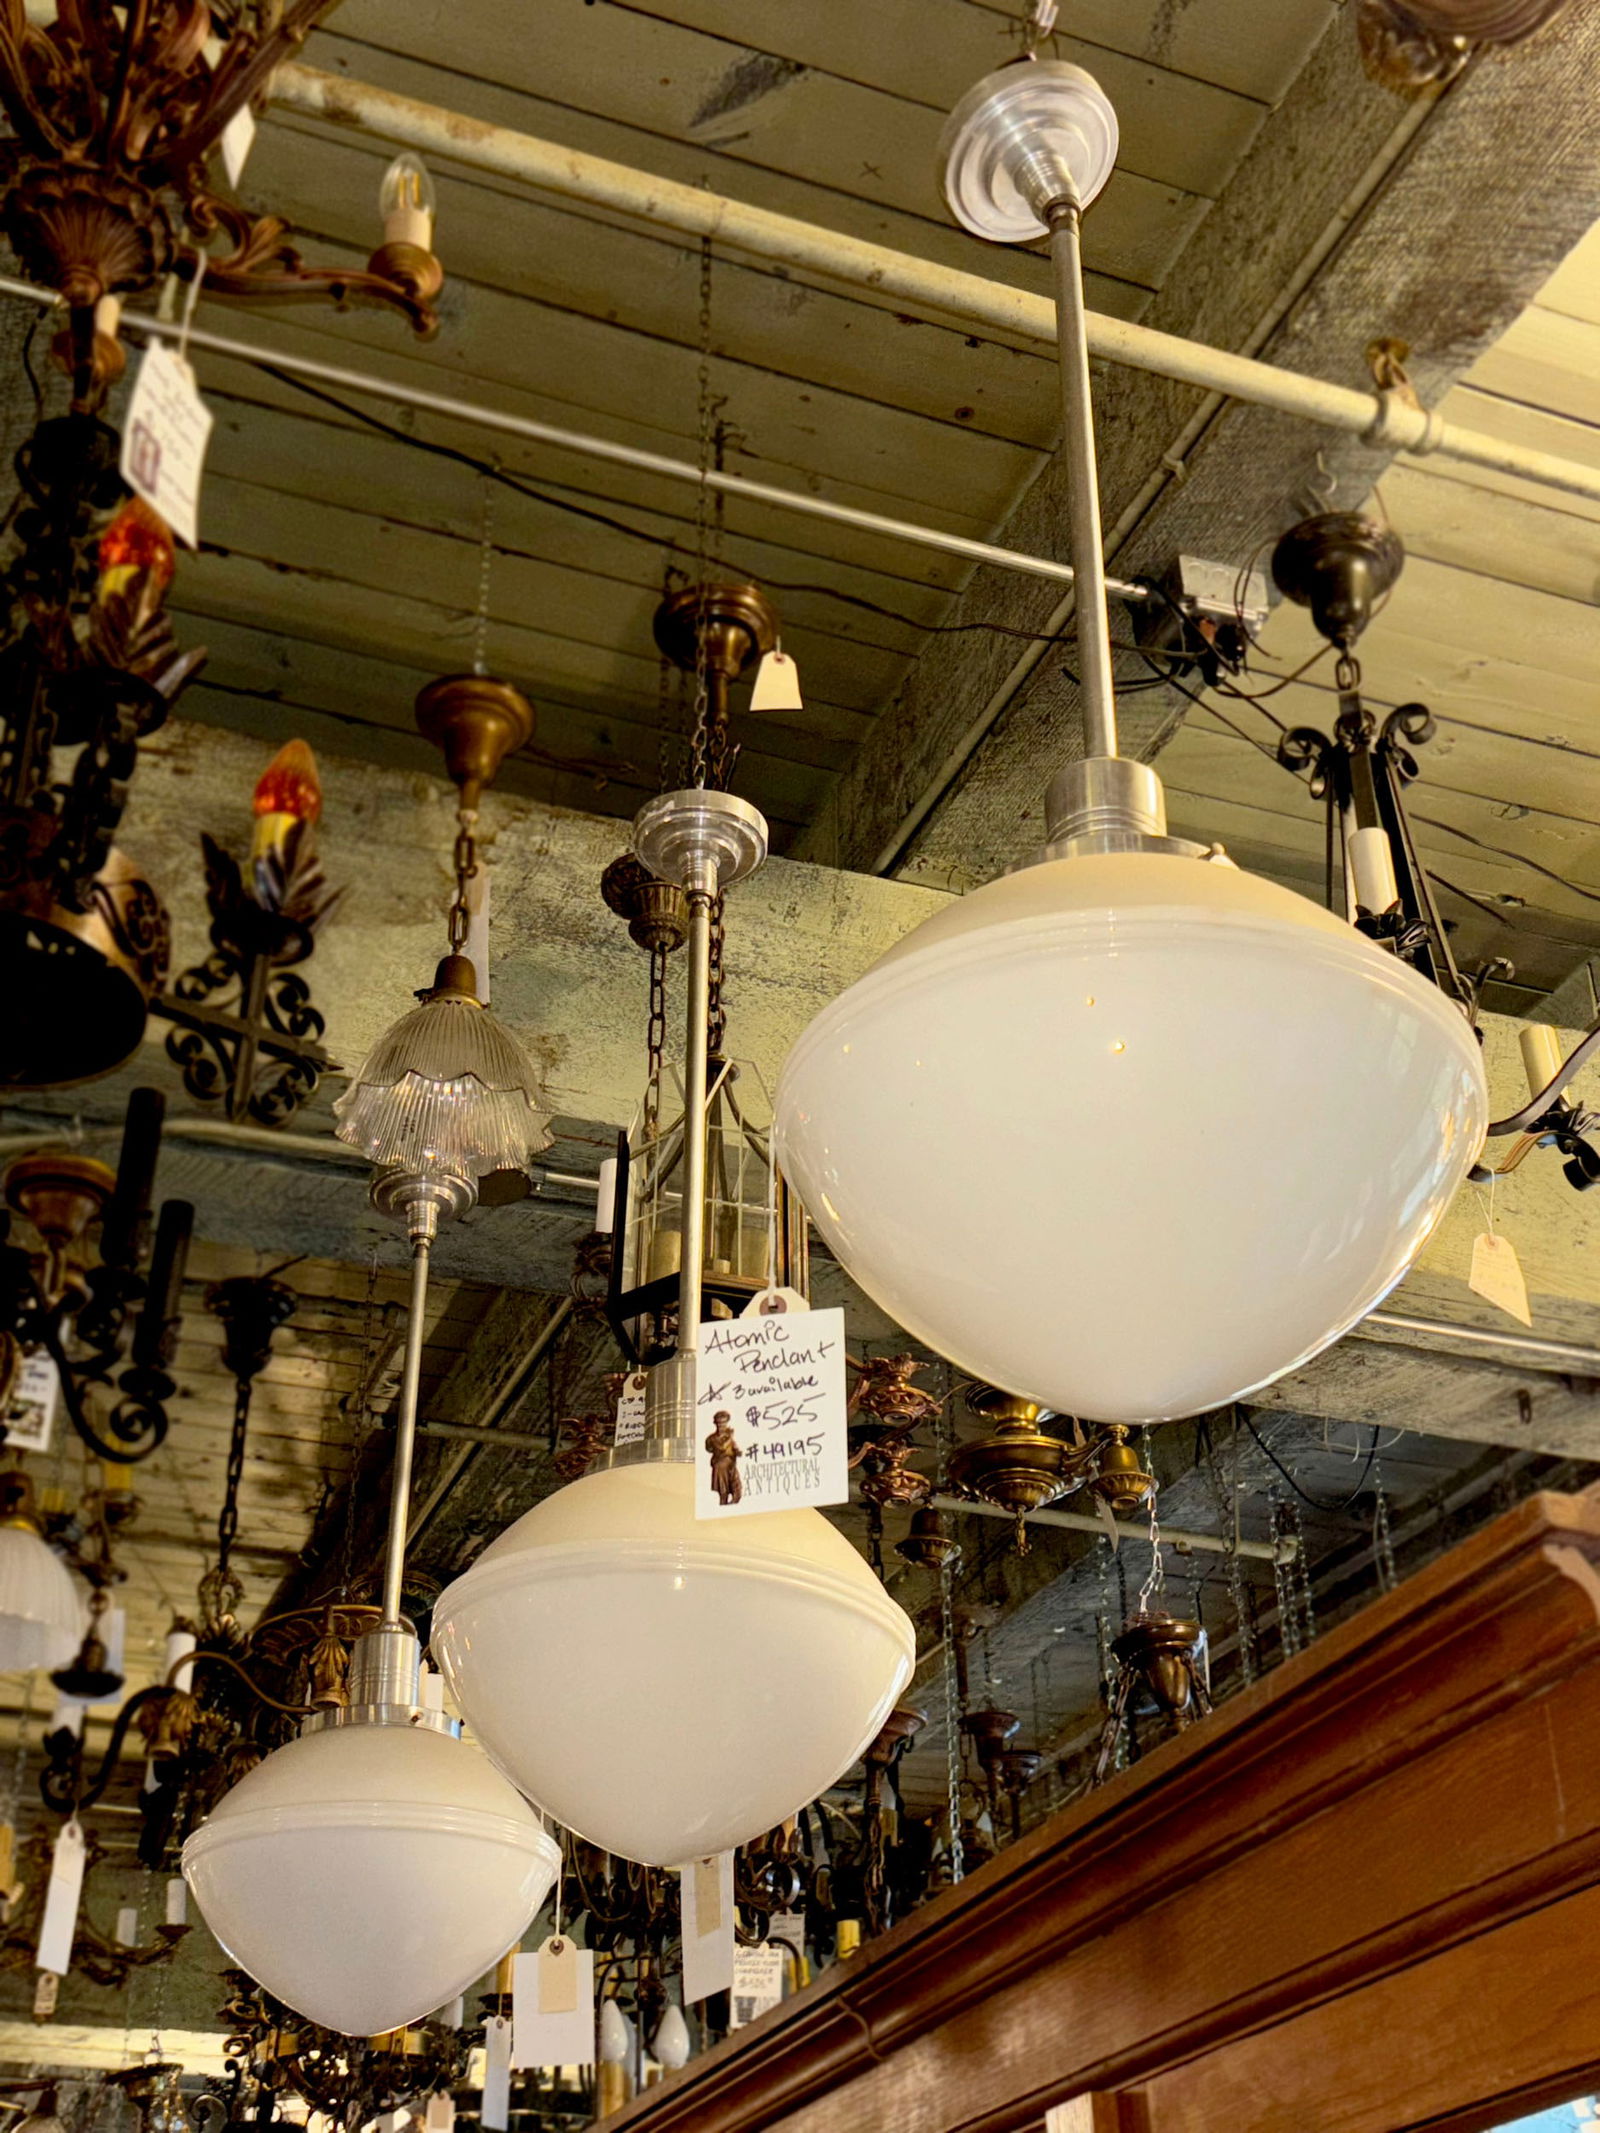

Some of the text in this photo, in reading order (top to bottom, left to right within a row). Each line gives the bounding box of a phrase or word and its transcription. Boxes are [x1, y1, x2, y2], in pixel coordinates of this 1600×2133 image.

[704, 1320, 790, 1354] Atomic
[733, 1341, 835, 1373] Pendant
[732, 1374, 819, 1400] 3 available
[746, 1393, 826, 1430] $525
[744, 1474, 820, 1498] ANTIQUES
